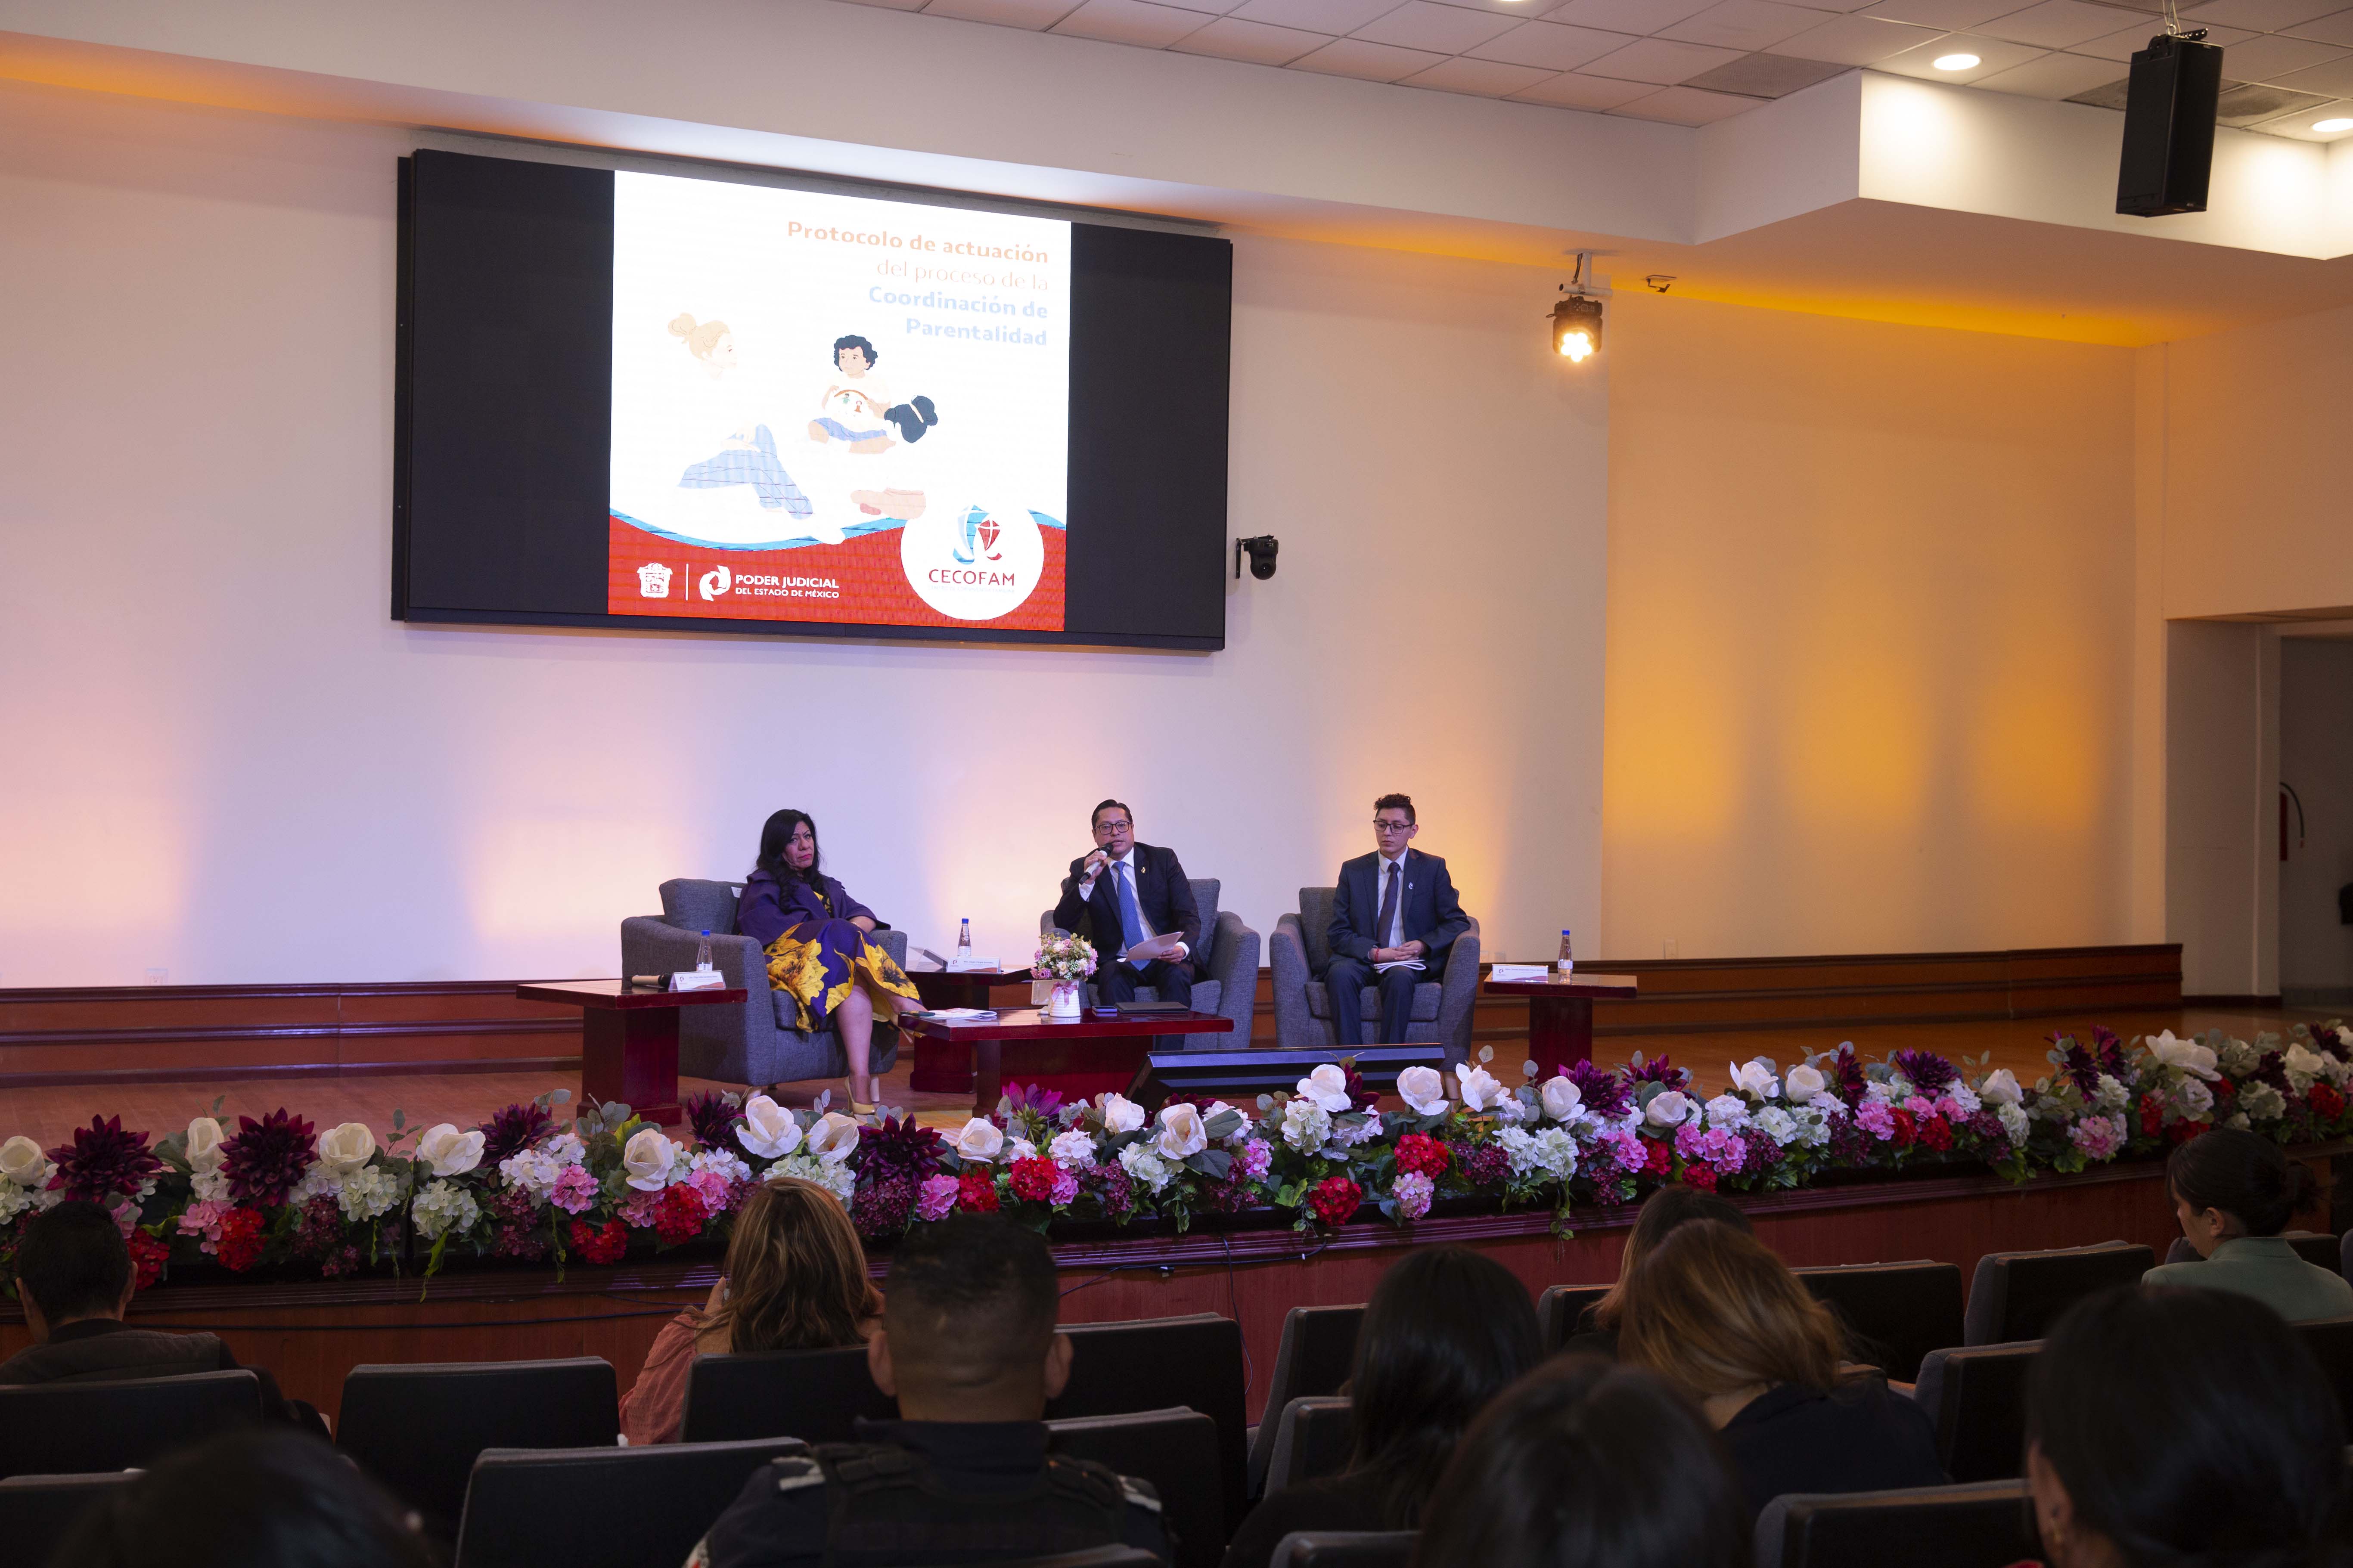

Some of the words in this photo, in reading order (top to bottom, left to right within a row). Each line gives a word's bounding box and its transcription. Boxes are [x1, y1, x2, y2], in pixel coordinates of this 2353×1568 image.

[788, 221, 903, 248] Protocolo
[910, 235, 935, 251] de
[943, 242, 1048, 263] actuación
[877, 259, 906, 276] del
[916, 266, 995, 285] proceso
[1002, 272, 1025, 289] de
[1034, 274, 1047, 291] la
[869, 286, 1015, 315] Coordinación
[1023, 301, 1048, 318] de
[906, 318, 1046, 345] Parentalidad
[736, 574, 779, 586] PODER
[782, 576, 839, 589] JUDICIAL
[928, 569, 1015, 586] CECOFAM
[754, 588, 788, 597] ESTADO
[805, 589, 839, 598] MÉXICO
